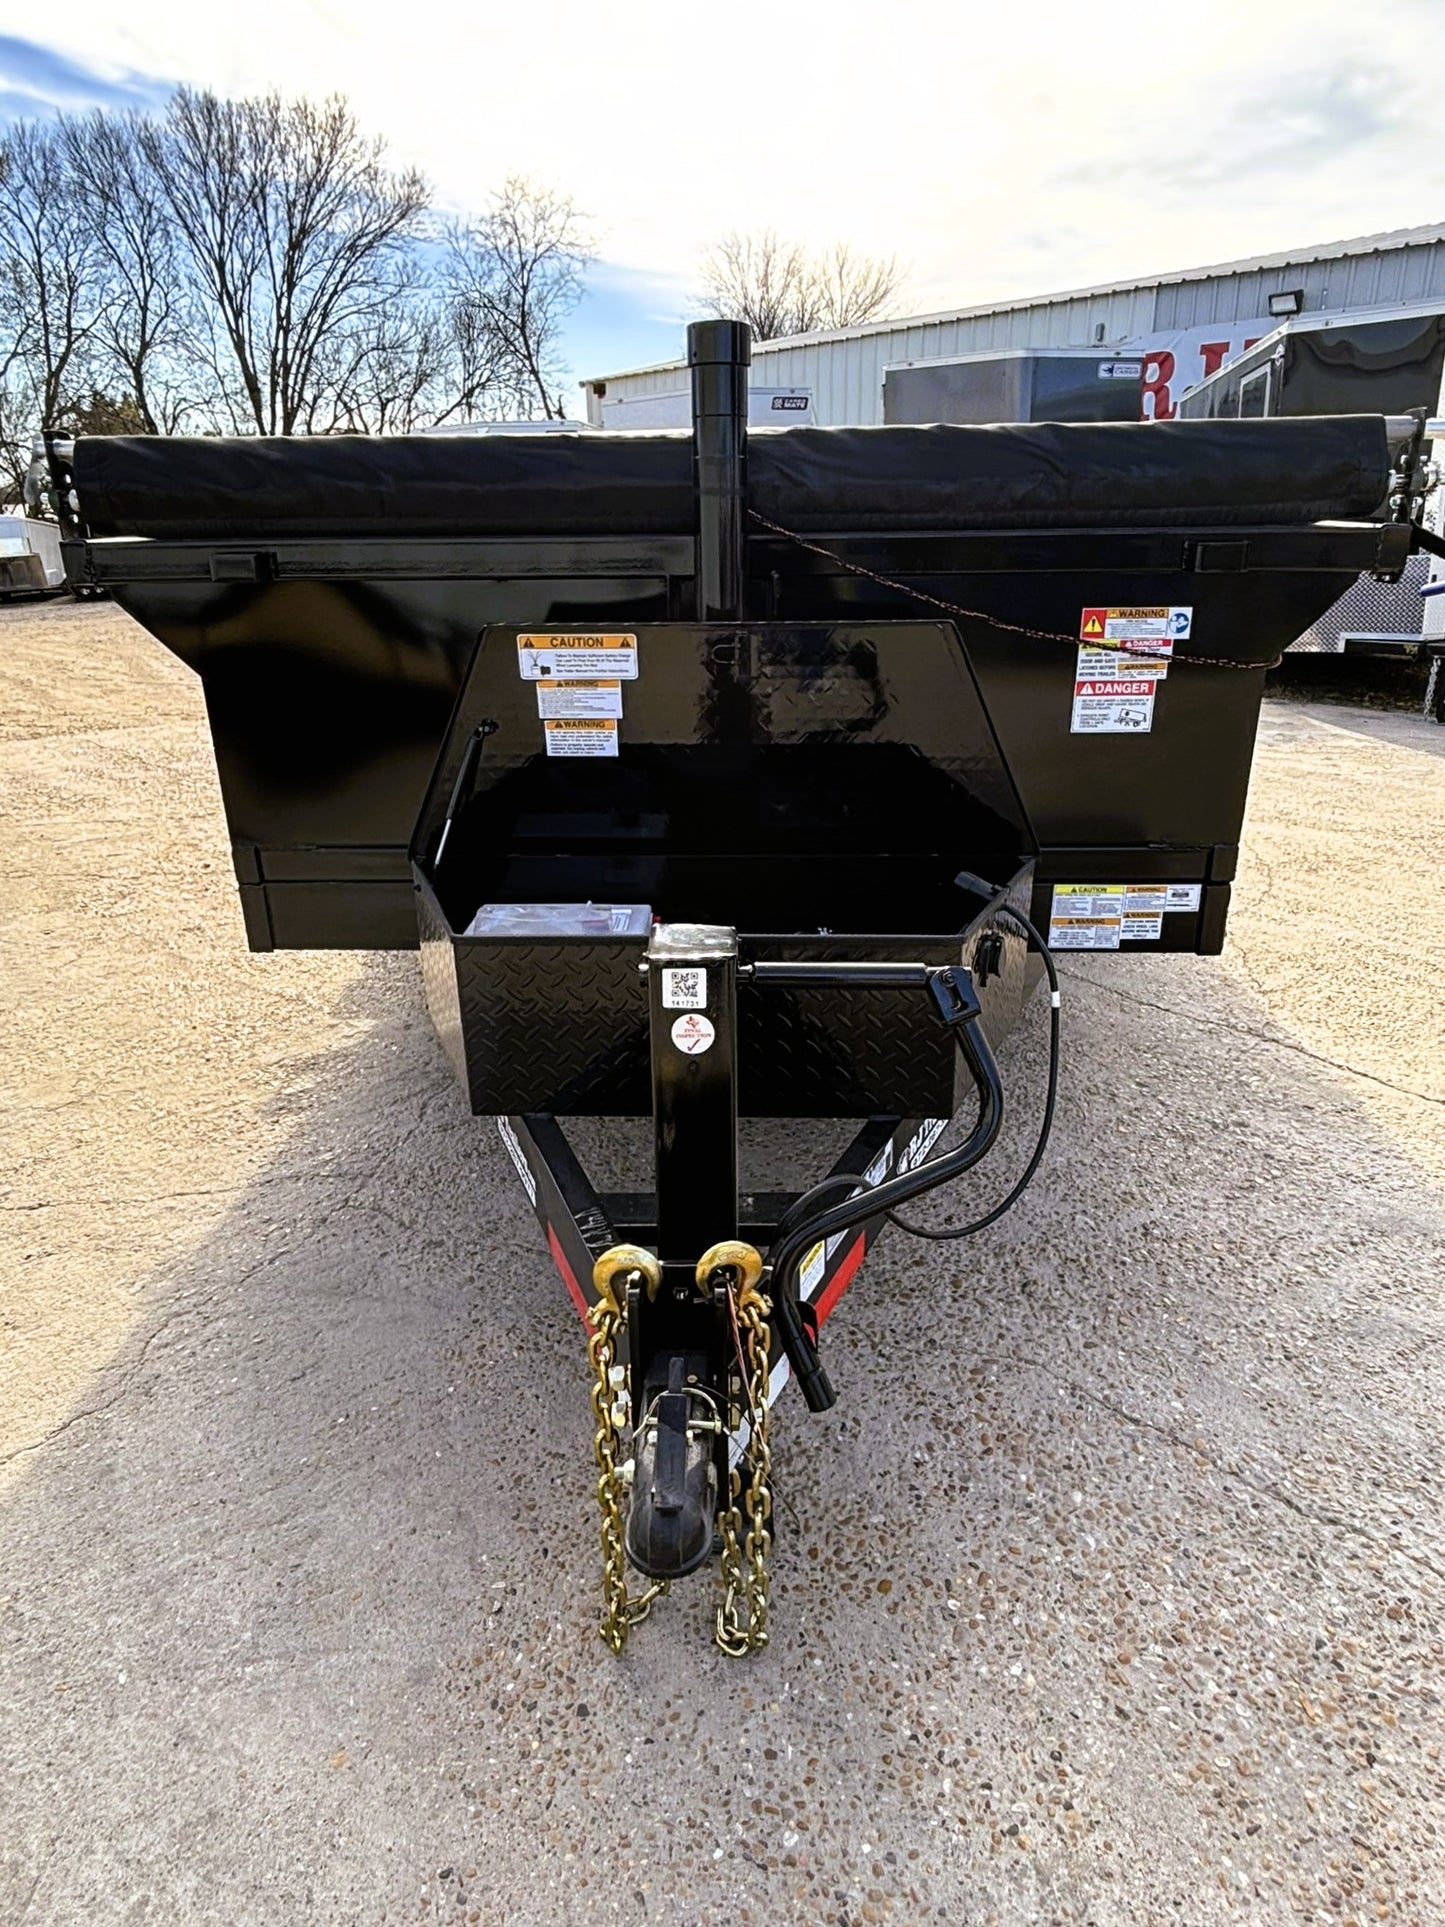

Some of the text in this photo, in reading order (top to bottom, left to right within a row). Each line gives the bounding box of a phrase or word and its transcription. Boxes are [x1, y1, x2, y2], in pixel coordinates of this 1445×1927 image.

[1120, 609, 1165, 618] WARNING
[550, 637, 604, 648] CAUTION
[1095, 683, 1149, 693] DANGER
